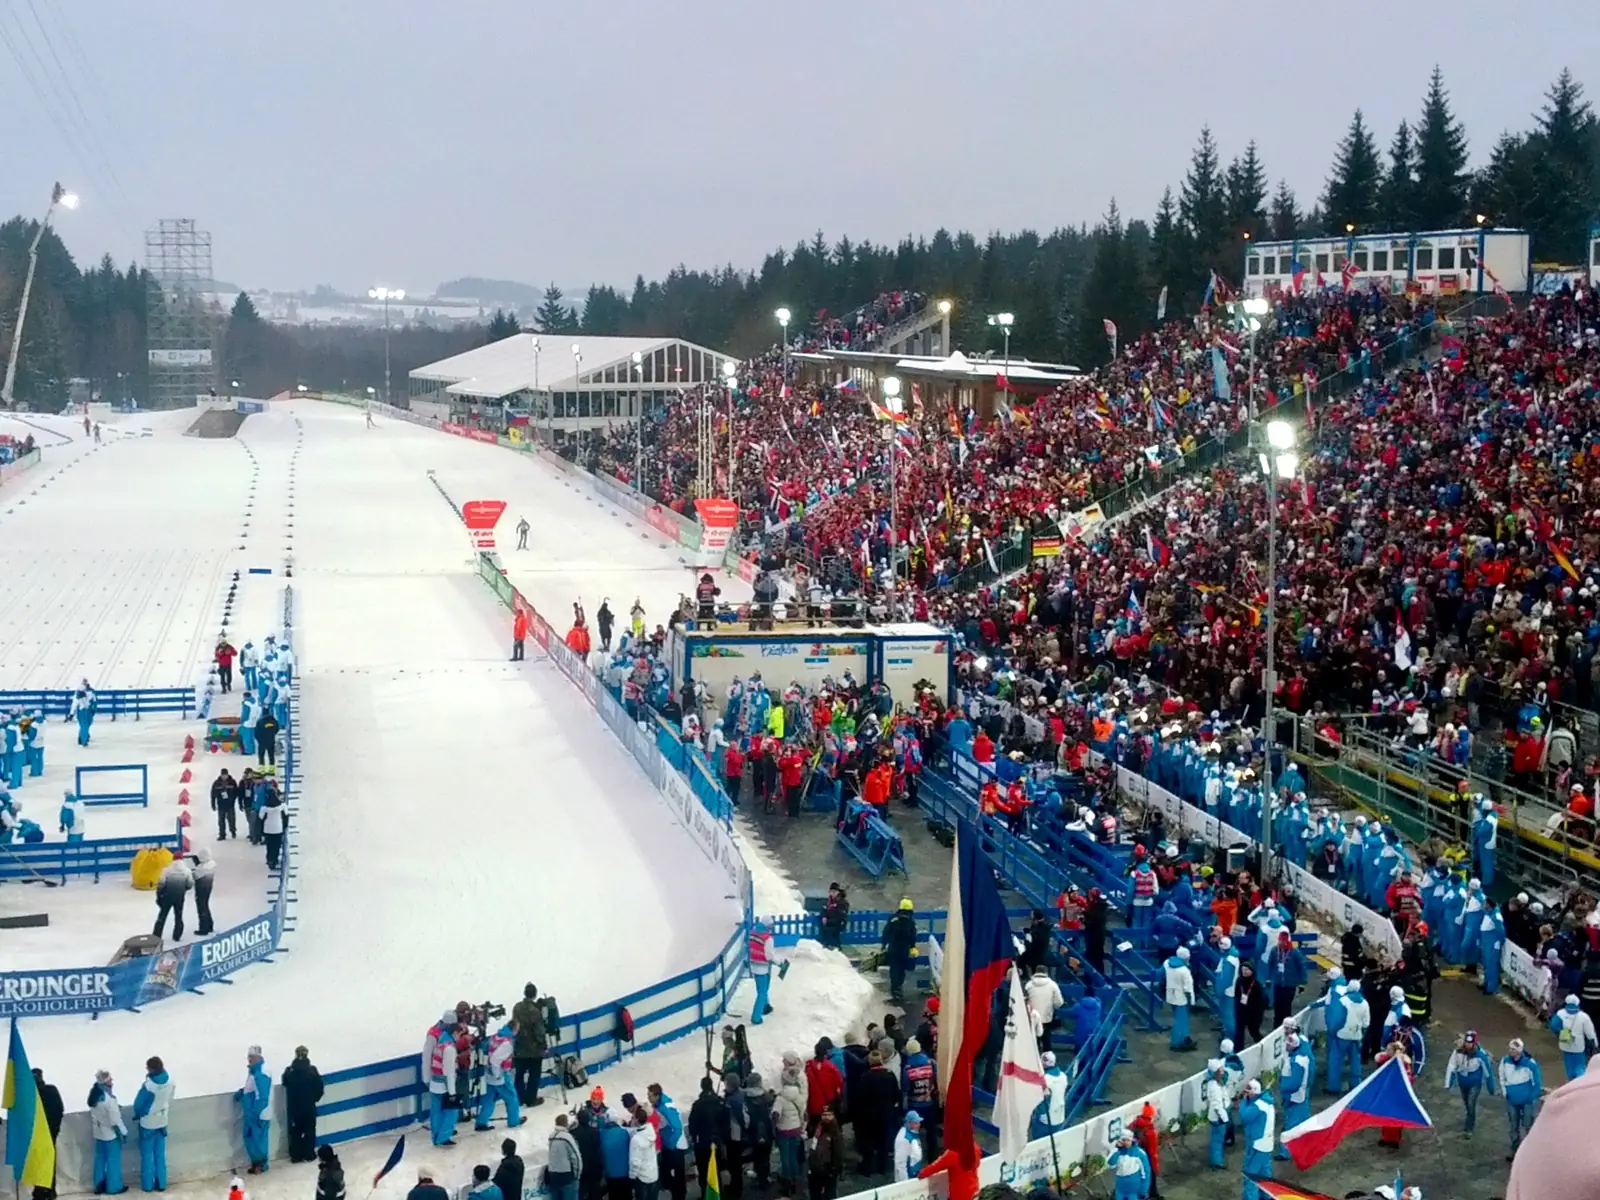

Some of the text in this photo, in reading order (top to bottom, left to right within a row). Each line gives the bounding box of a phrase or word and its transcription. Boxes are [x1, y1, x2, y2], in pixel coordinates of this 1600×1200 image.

[201, 941, 273, 982] ALKOHOLFREI
[202, 919, 273, 967] ERDINGER
[0, 997, 114, 1014] LKOHOLFREI
